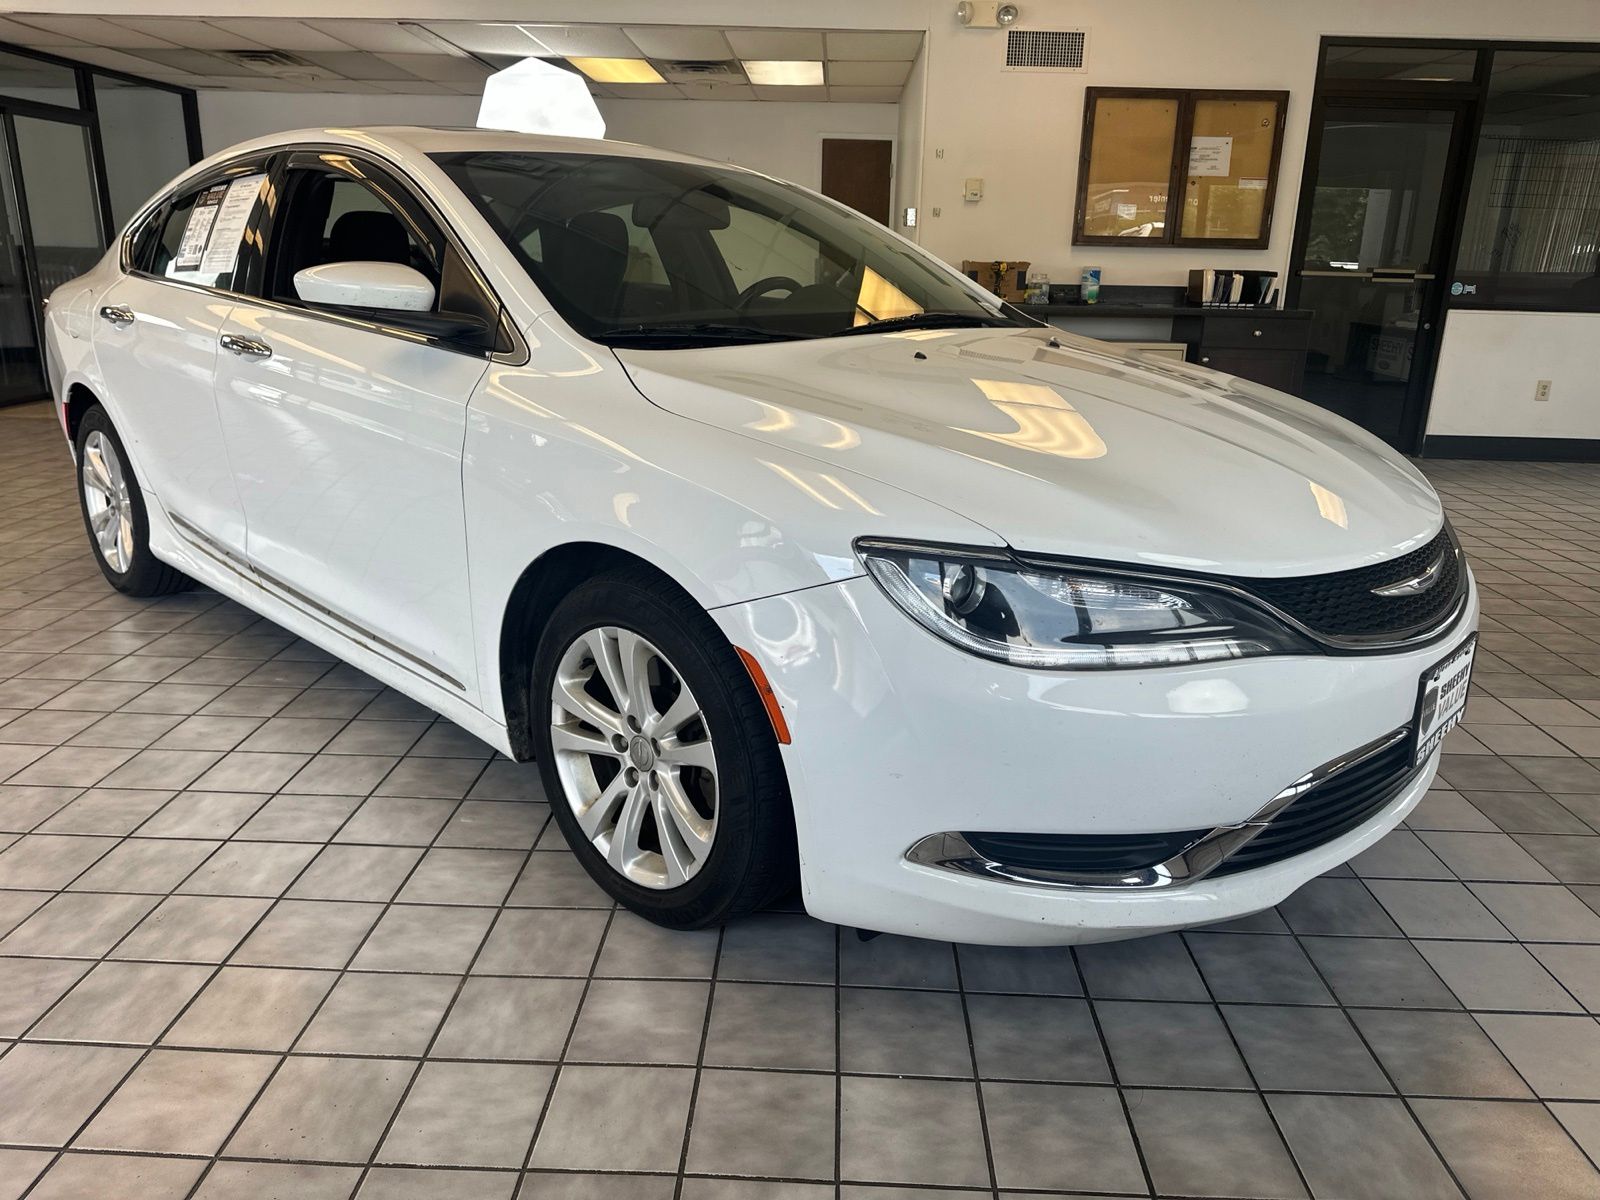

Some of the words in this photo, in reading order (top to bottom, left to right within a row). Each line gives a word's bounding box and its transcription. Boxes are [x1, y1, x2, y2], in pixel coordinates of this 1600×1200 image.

[1438, 678, 1468, 720] VALUE
[1440, 661, 1471, 700] SHEEHY
[1416, 705, 1465, 766] SHEEHY
